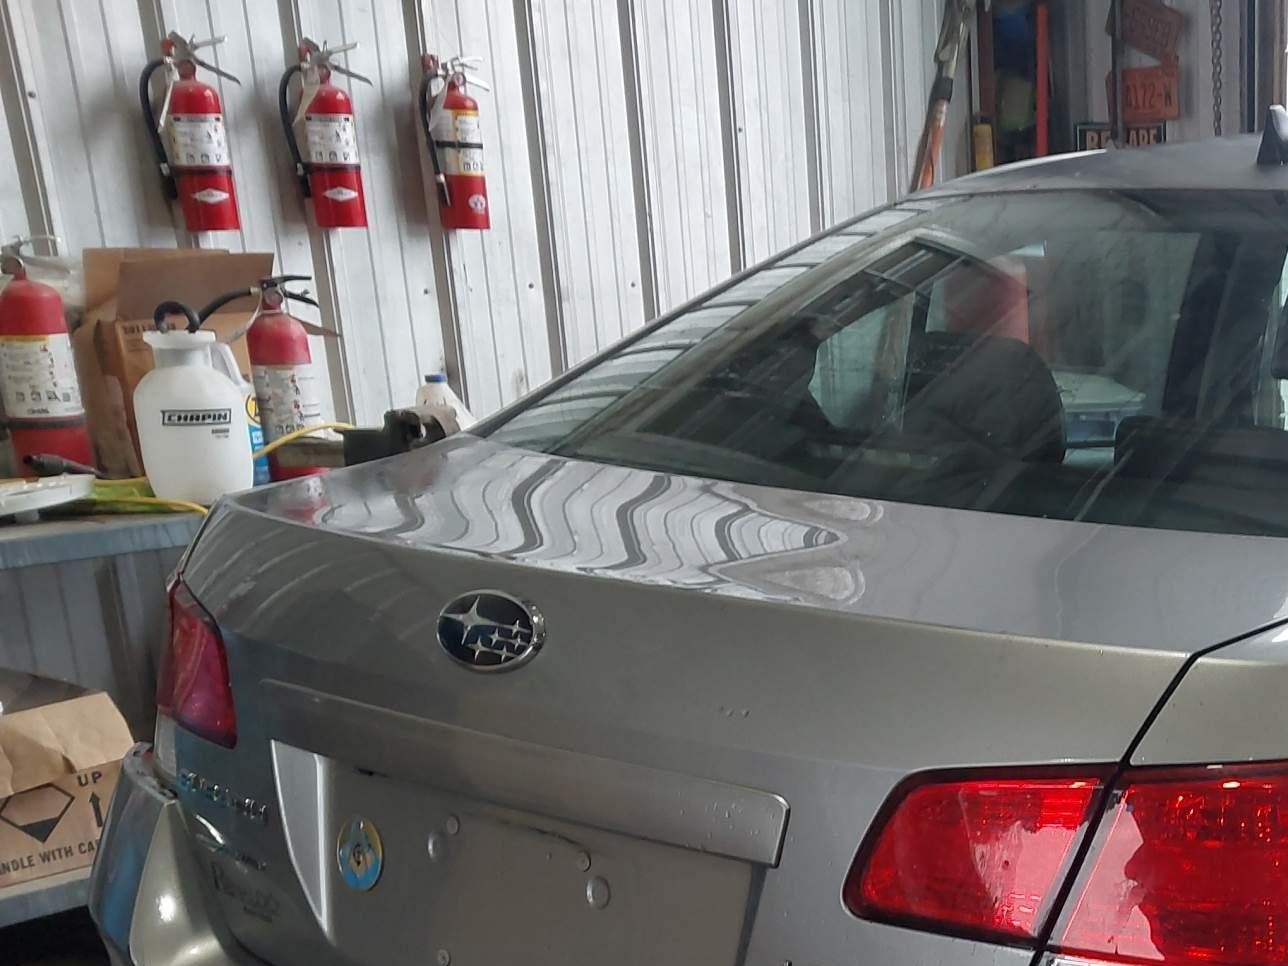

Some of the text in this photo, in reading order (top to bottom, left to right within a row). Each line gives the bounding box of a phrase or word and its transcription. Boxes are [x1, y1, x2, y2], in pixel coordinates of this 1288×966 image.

[167, 411, 228, 422] CHAPIN
[77, 771, 103, 787] UP
[0, 839, 101, 875] NDLE WITH CA
